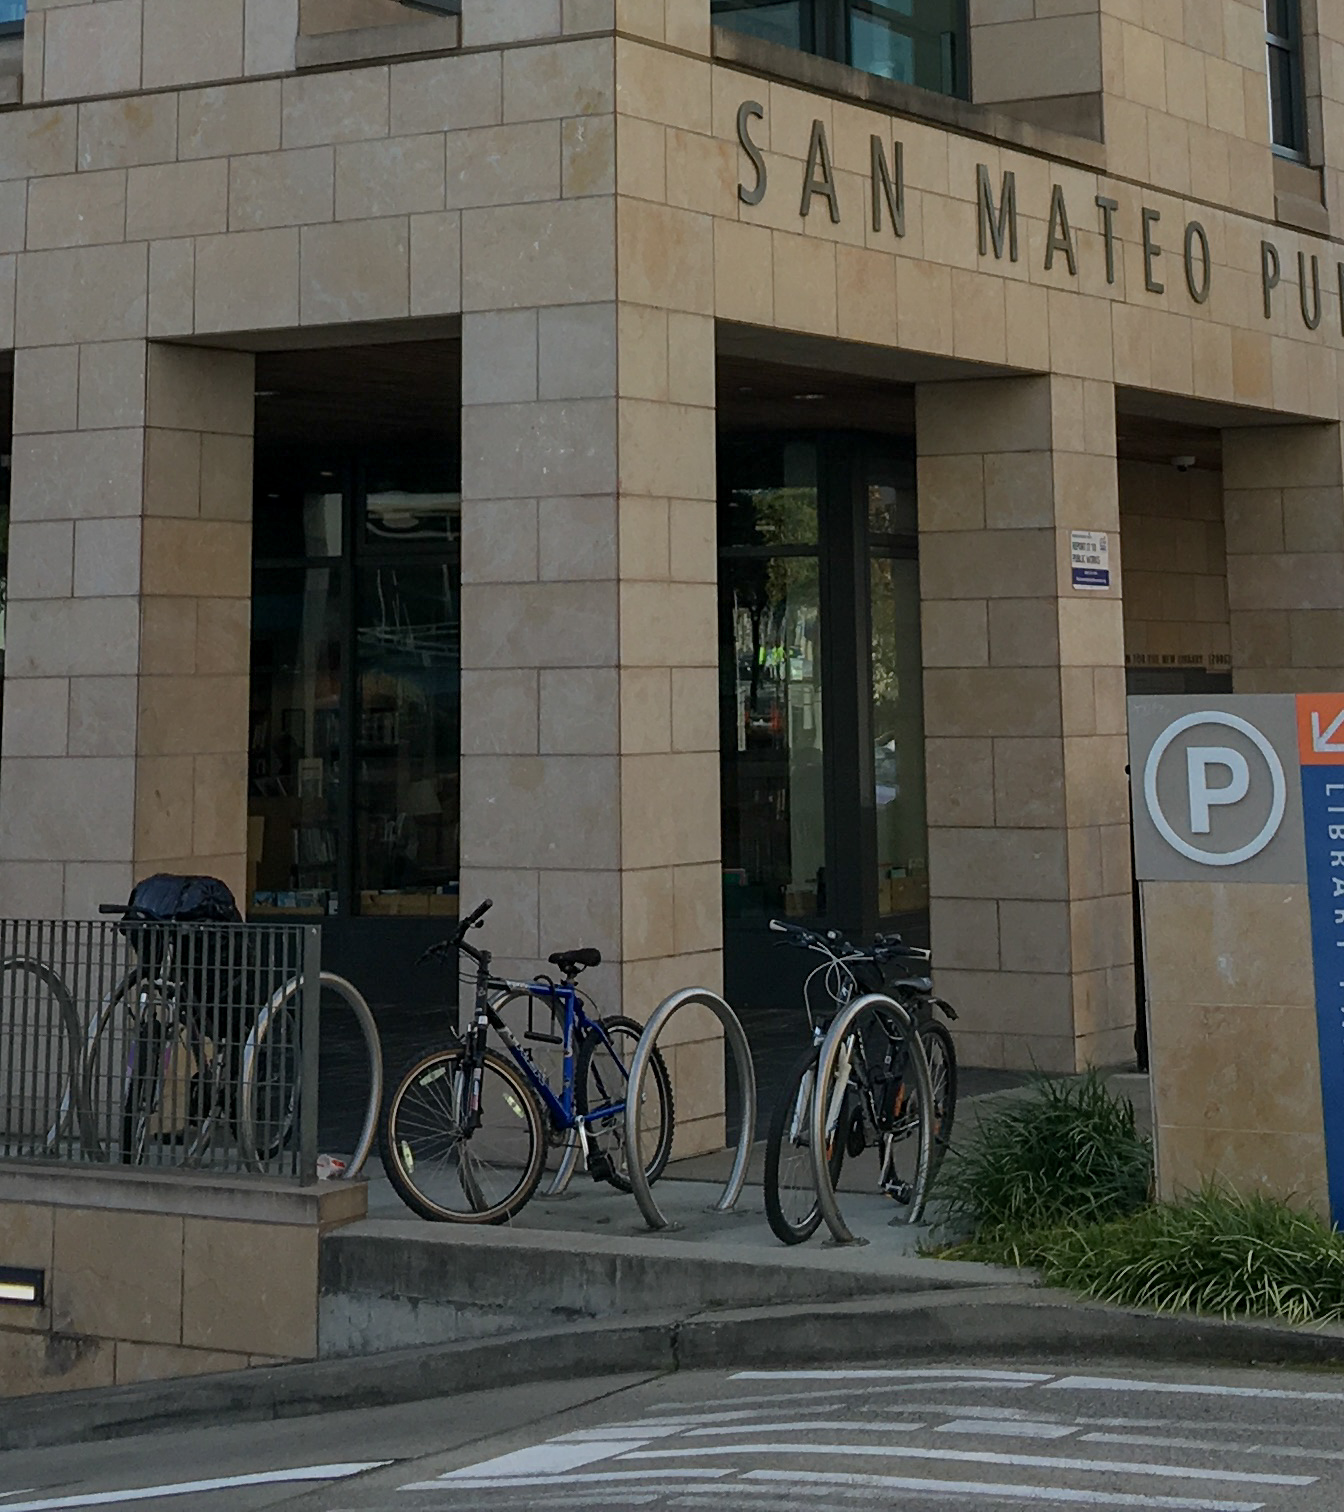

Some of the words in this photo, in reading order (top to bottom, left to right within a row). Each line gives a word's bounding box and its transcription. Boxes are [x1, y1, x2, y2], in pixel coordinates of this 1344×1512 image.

[736, 99, 908, 238] SAN
[975, 162, 1213, 306] MATEO
[1186, 746, 1251, 834] P
